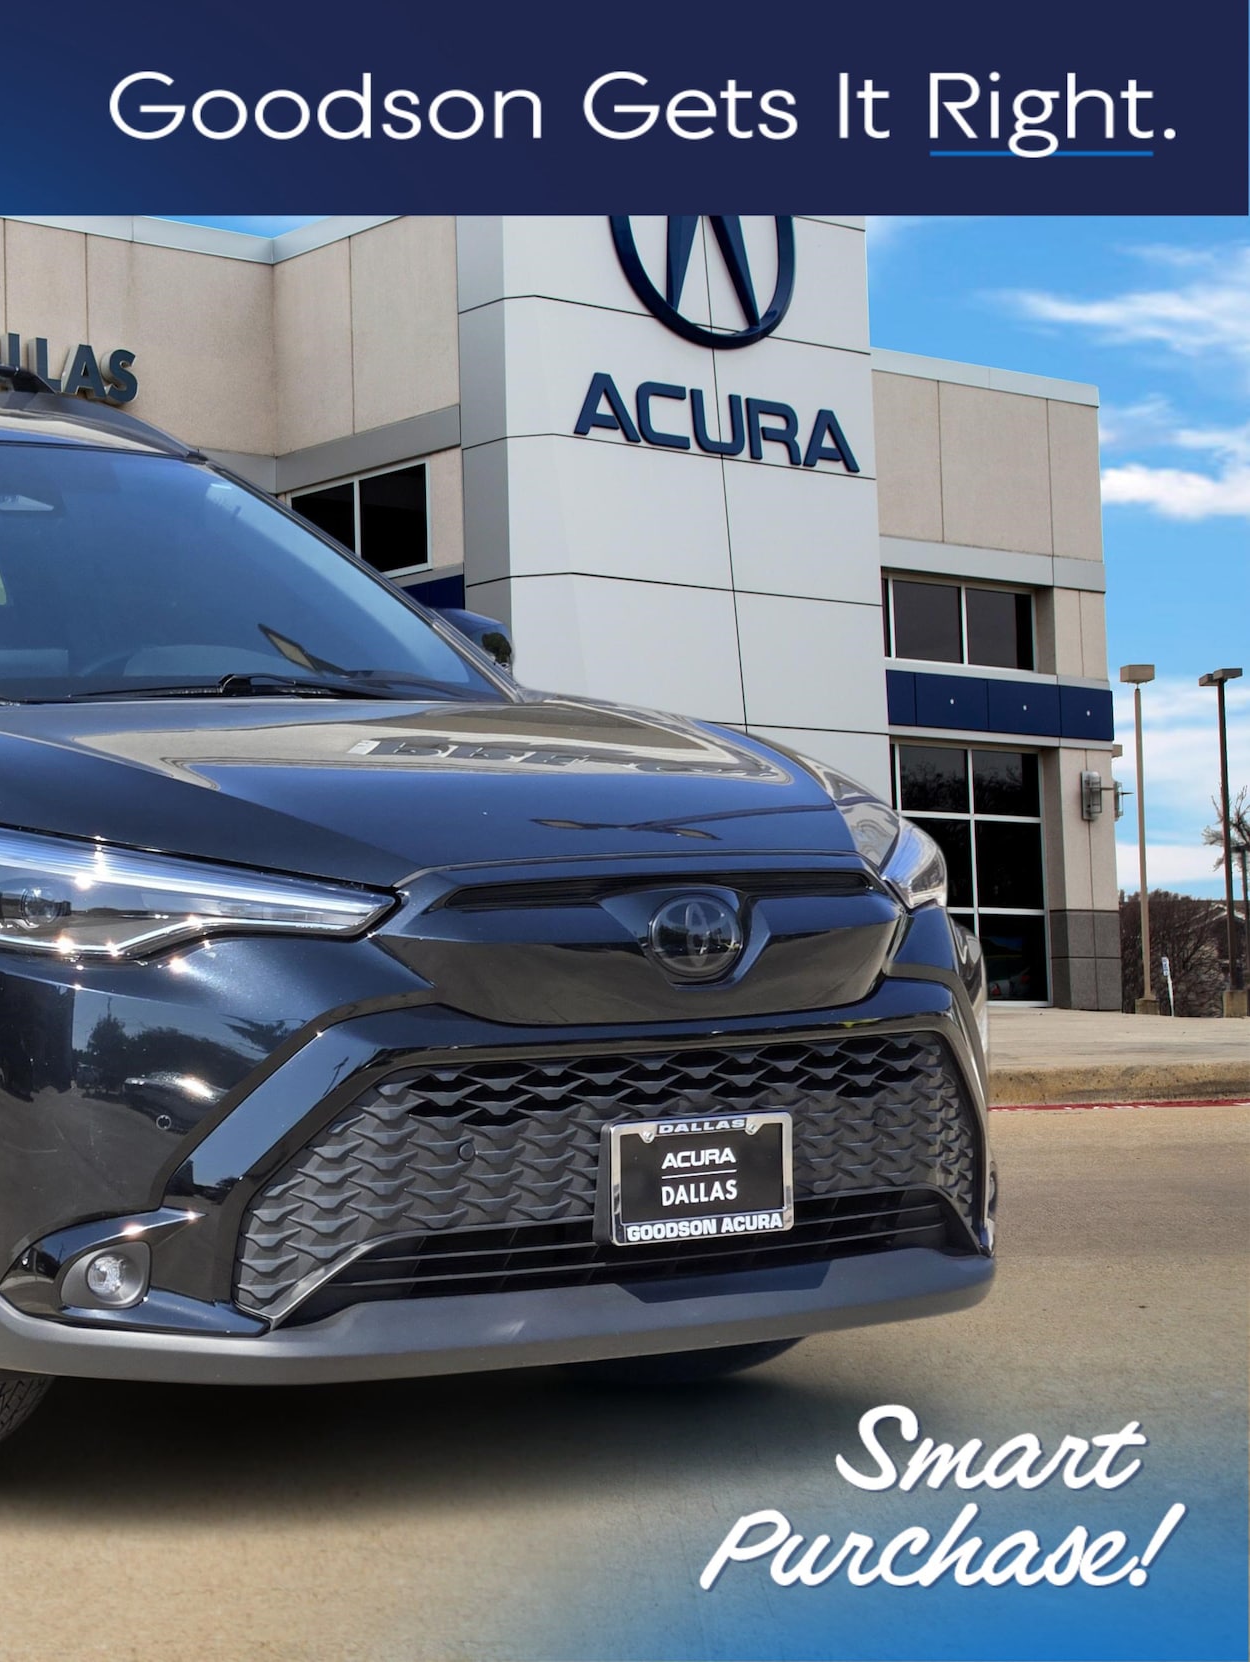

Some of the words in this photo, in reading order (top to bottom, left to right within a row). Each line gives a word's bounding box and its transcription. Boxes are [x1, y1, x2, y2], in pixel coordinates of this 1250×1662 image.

[574, 371, 861, 473] ACURA
[658, 1118, 747, 1135] DALLAS
[661, 1147, 737, 1170] ACURA
[661, 1179, 738, 1207] DALLAS
[626, 1217, 717, 1242] GOODSON
[720, 1212, 784, 1234] ACURA
